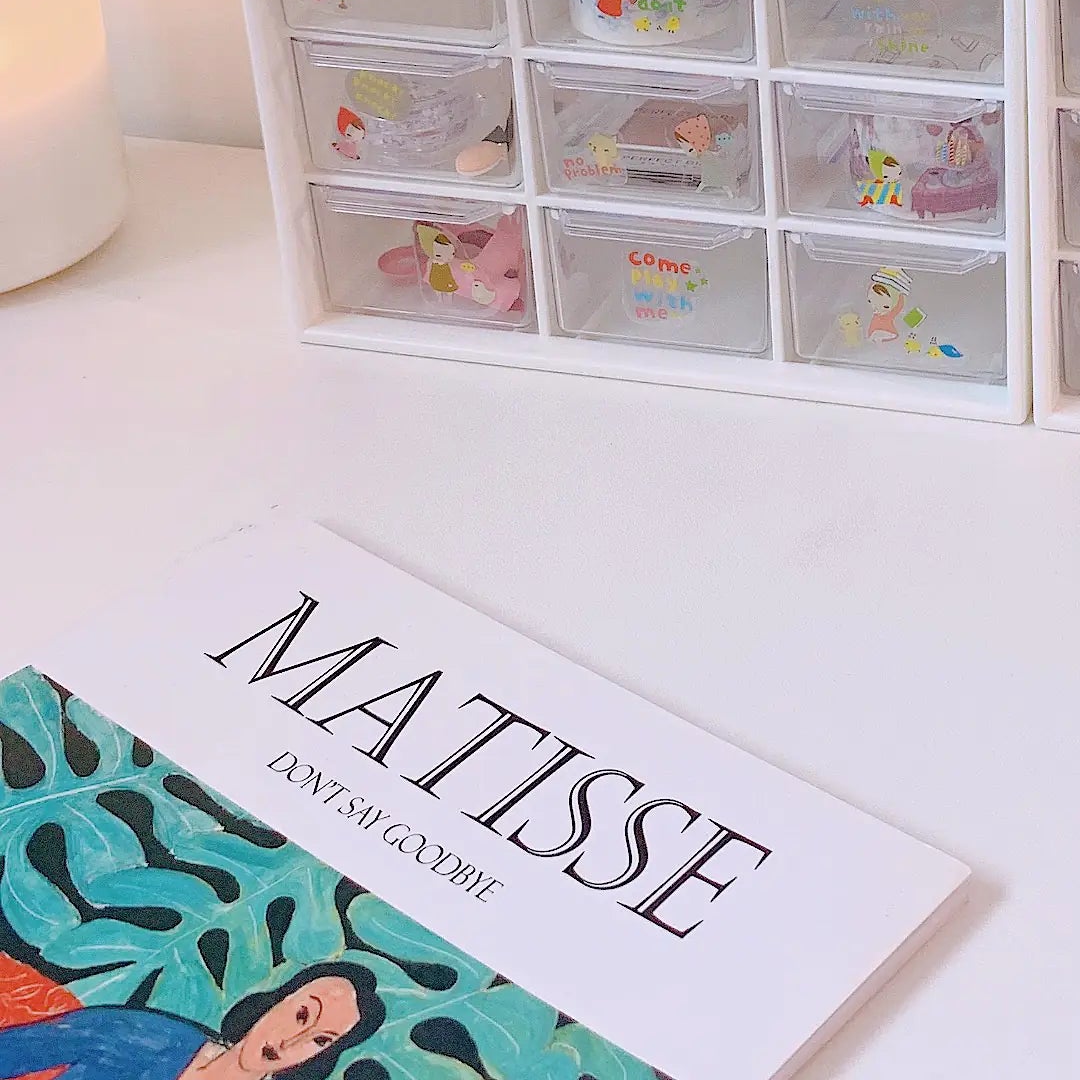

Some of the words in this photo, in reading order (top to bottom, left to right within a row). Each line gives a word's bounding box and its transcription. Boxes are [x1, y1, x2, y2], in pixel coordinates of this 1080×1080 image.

[563, 158, 584, 169] no
[629, 252, 691, 275] come
[636, 306, 668, 319] me
[203, 590, 773, 939] MATISSE
[266, 751, 351, 804] DON'T
[337, 796, 391, 830] SAY
[382, 823, 504, 903] GOODBYE
